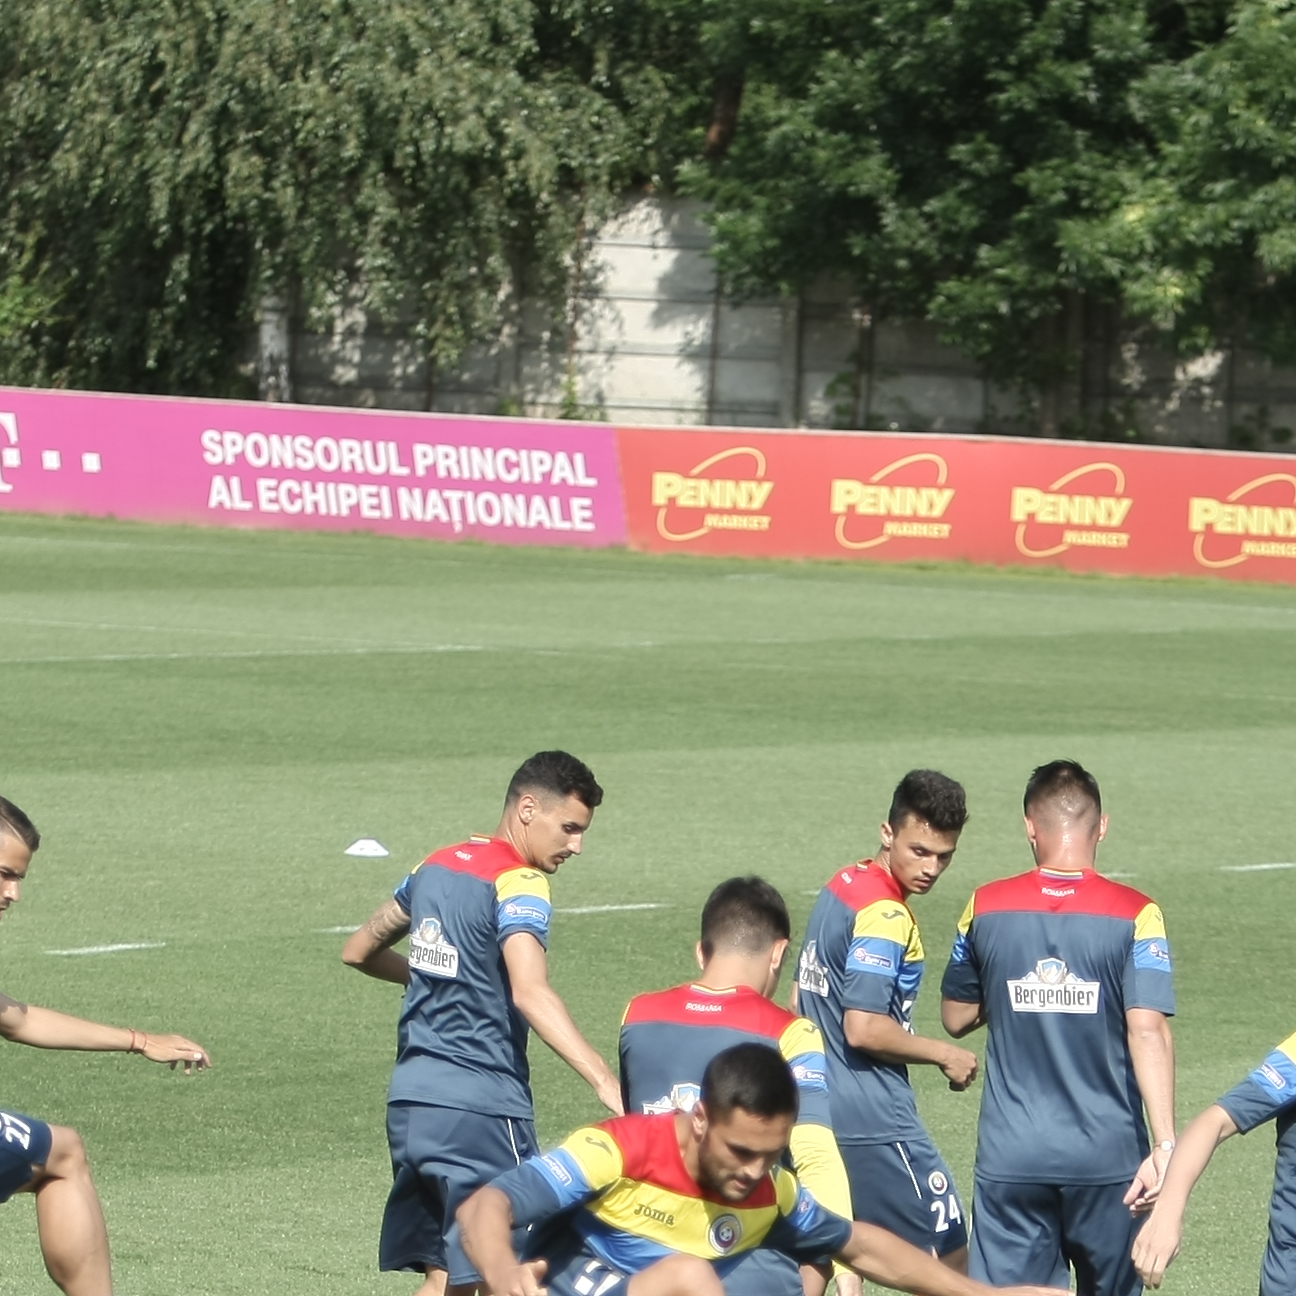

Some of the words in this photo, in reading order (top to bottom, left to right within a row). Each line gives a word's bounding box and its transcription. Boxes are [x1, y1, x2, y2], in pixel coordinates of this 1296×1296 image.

[201, 430, 410, 476] SPONSORUL
[412, 443, 597, 486] PRINCIPAL
[208, 475, 252, 510] AL
[256, 477, 391, 518] ECHIPEI
[652, 472, 774, 510] PENNY
[831, 479, 955, 517] PENNY
[1010, 486, 1133, 527] PENNY
[1014, 985, 1094, 1007] Bergenbier
[930, 1194, 961, 1232] 24
